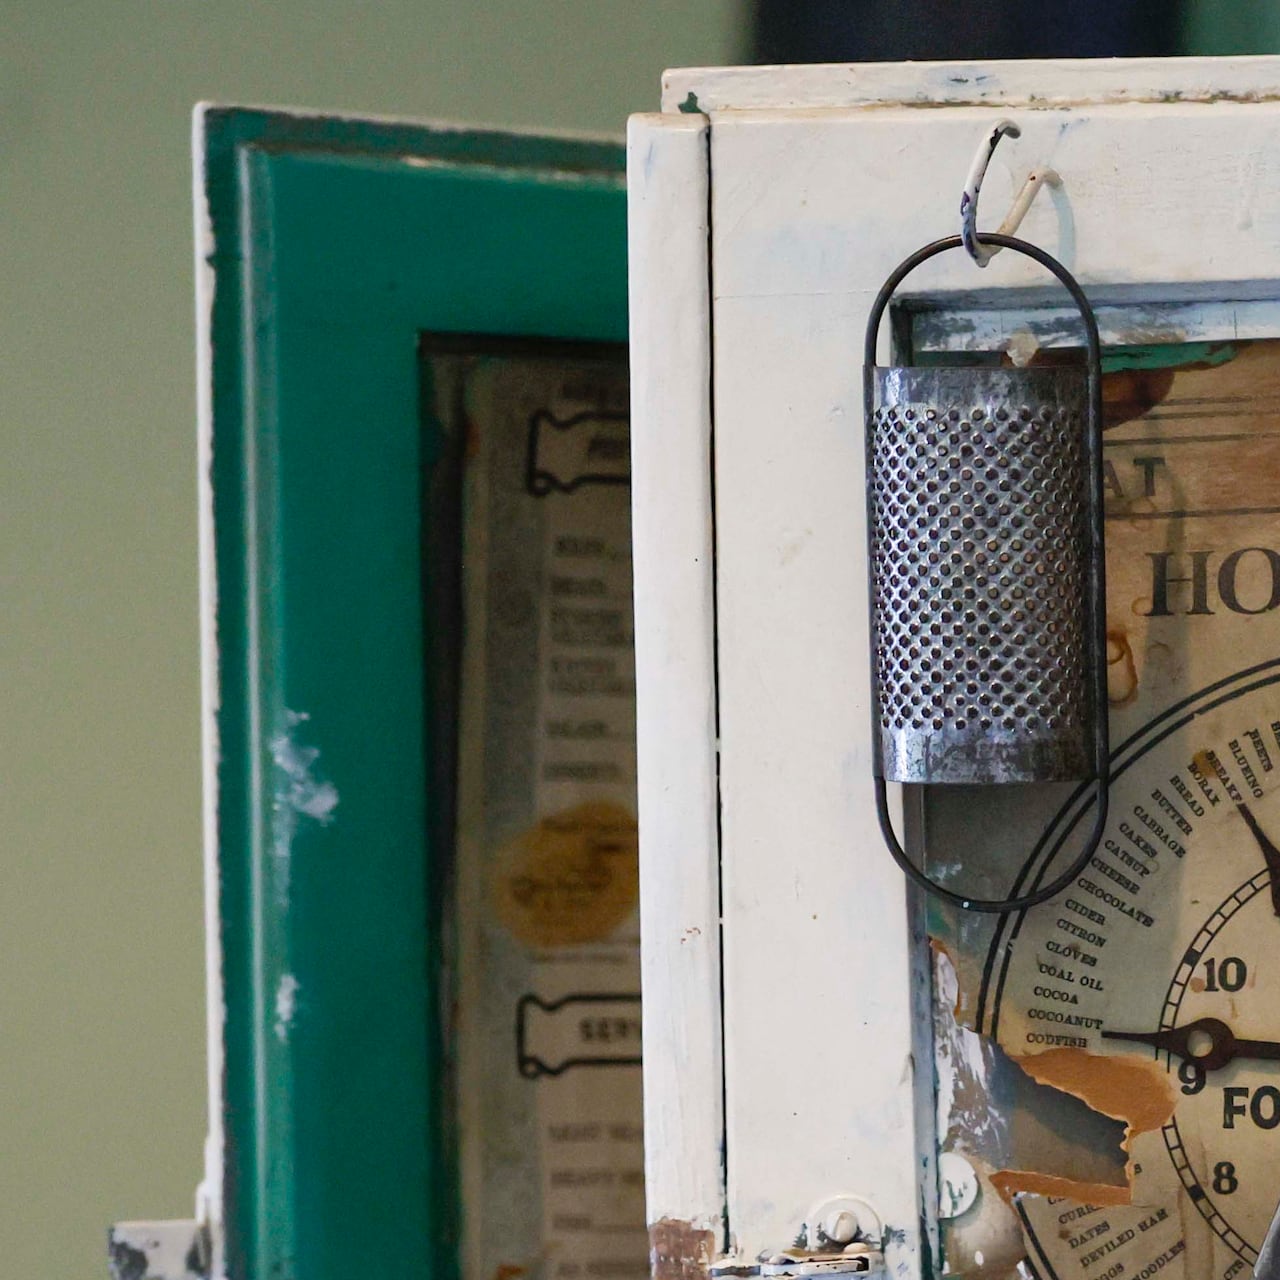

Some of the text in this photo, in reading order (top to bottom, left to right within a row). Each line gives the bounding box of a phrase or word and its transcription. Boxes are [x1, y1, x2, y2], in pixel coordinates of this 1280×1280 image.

[1248, 728, 1273, 773] BEETS
[1169, 775, 1205, 817] BREAD
[1187, 762, 1220, 807] BORAX
[1151, 789, 1194, 837] BUTTER
[1119, 822, 1158, 860] CAKES
[1133, 805, 1187, 859] CABBAGE
[1090, 857, 1141, 896] CHEESE
[1104, 839, 1151, 879] CATSUP
[1065, 899, 1106, 927] CIDER
[1077, 877, 1156, 928] CHOCOLATE
[1056, 918, 1108, 948] CITRON
[1045, 940, 1098, 968] CLOVES
[1038, 963, 1105, 992] COAL OIL
[1203, 957, 1247, 993] 10
[1033, 985, 1079, 1005] COCOA
[1027, 1008, 1104, 1030] COCOANUT
[1026, 1032, 1088, 1048] CODFISH
[1178, 1061, 1208, 1096] 9
[1213, 1162, 1239, 1196] 8
[1068, 1221, 1111, 1250] DATES
[1079, 1208, 1169, 1268] DEVILED HAM
